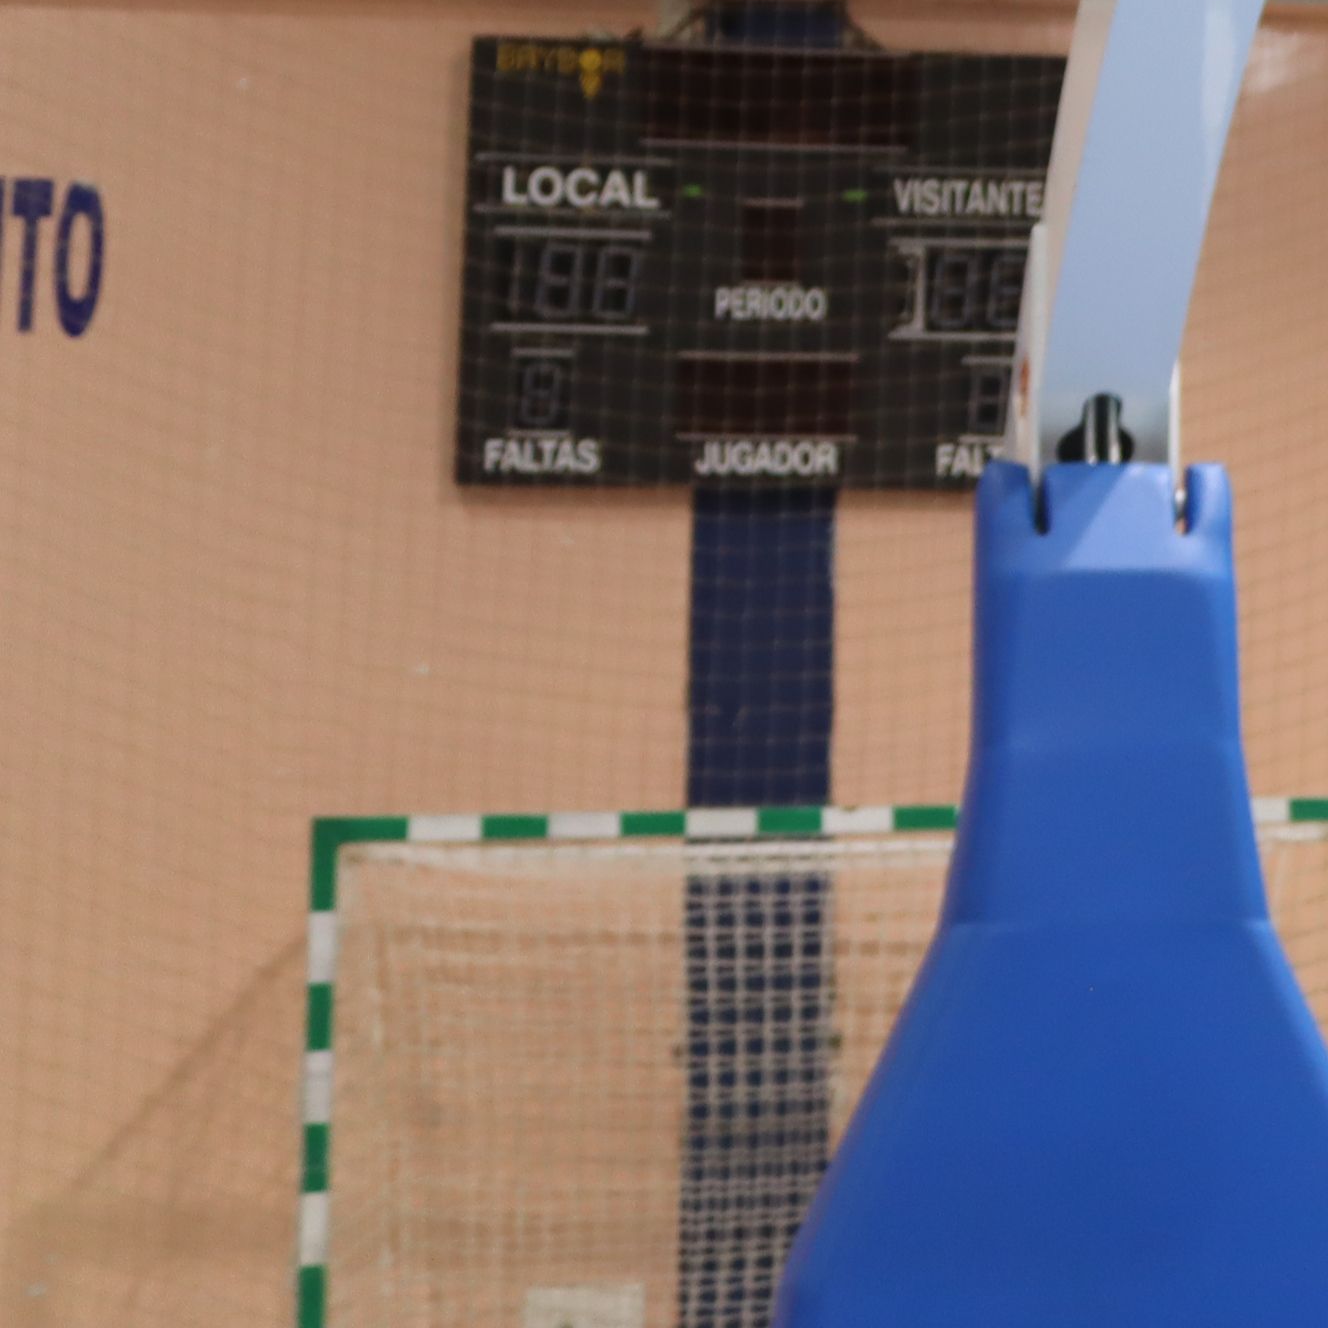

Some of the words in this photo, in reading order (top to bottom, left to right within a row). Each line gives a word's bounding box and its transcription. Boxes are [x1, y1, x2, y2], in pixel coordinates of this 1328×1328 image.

[501, 165, 660, 209] LOCAL
[893, 177, 1045, 218] VISITANTE
[0, 177, 104, 339] TO
[714, 284, 829, 322] PERIODO
[484, 437, 601, 473] FALTAS
[695, 441, 840, 476] JUGADOR
[935, 443, 1004, 477] FALT
